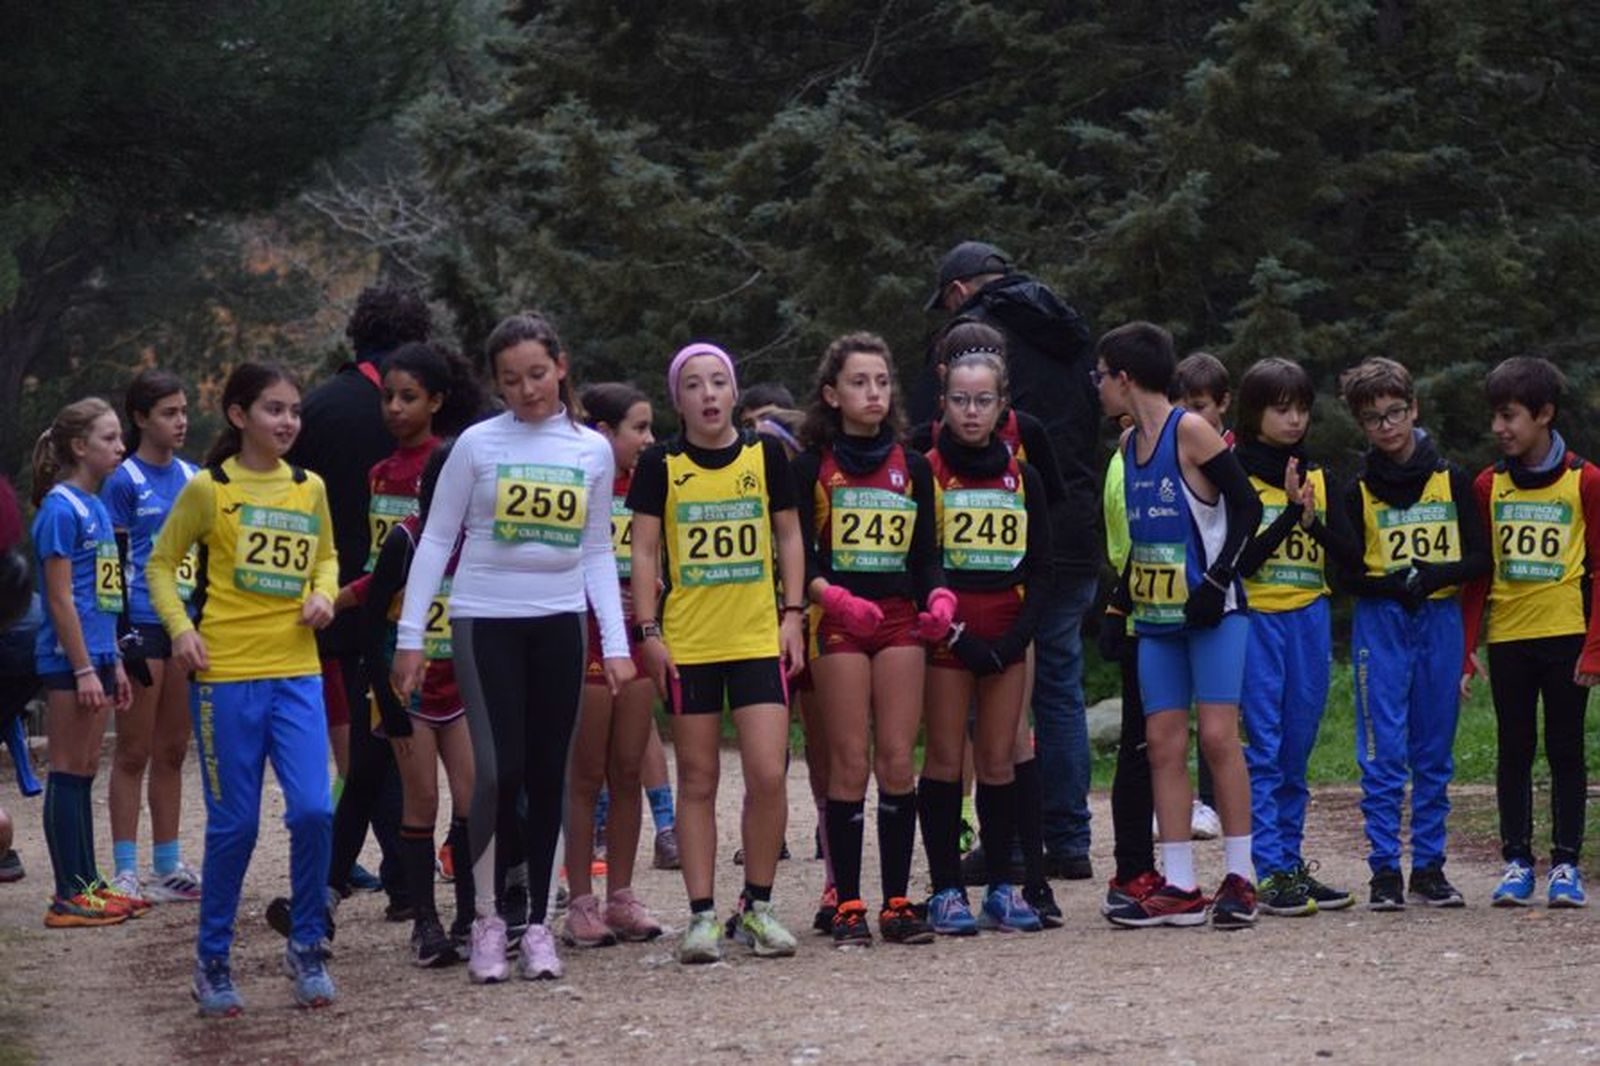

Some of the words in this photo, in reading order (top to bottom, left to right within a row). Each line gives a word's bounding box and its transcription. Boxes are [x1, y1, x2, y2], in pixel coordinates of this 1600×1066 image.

[506, 484, 577, 522] 259
[688, 524, 757, 559] 260
[841, 513, 906, 546] 243
[953, 512, 1018, 545] 248
[1388, 526, 1451, 561] 264
[1500, 525, 1560, 557] 266
[246, 532, 310, 571] 253
[1134, 566, 1176, 600] 277
